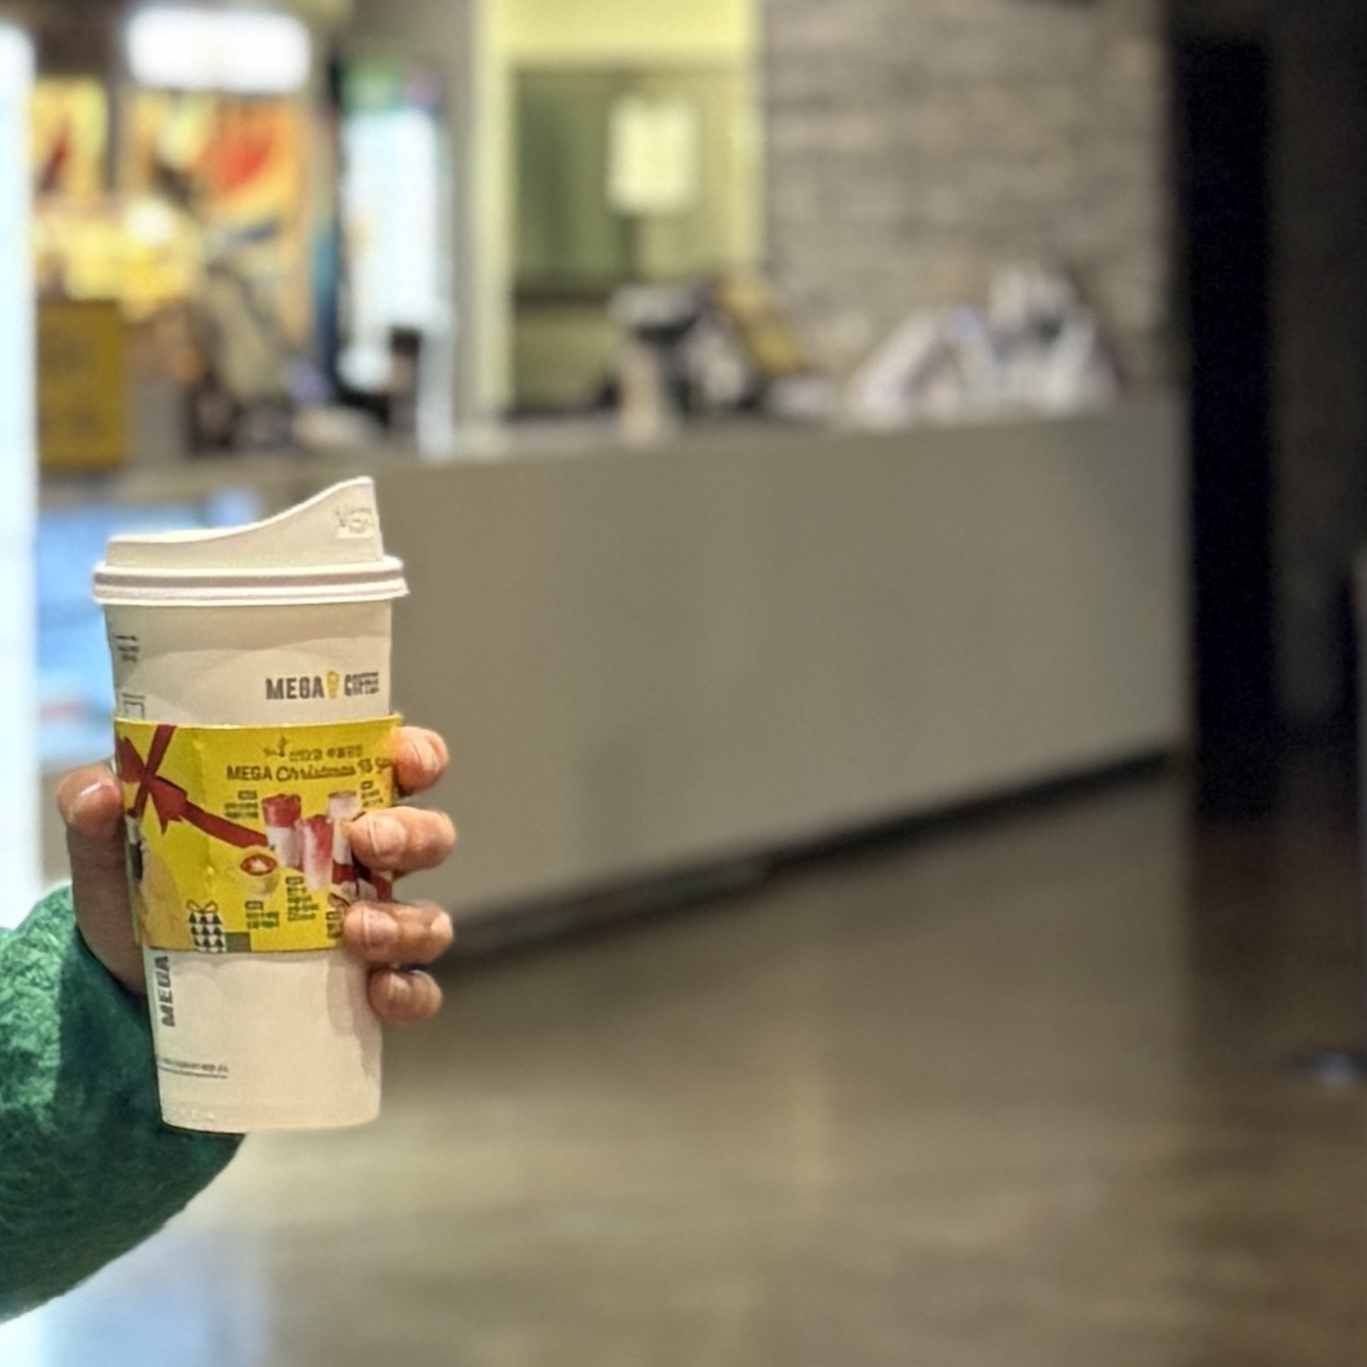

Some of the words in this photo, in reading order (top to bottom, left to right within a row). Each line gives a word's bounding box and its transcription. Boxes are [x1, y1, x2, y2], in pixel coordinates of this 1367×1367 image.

[265, 675, 325, 700] MEGA
[226, 763, 273, 782] MEGA
[275, 763, 356, 783] Christmas
[153, 955, 176, 1028] MEGA
